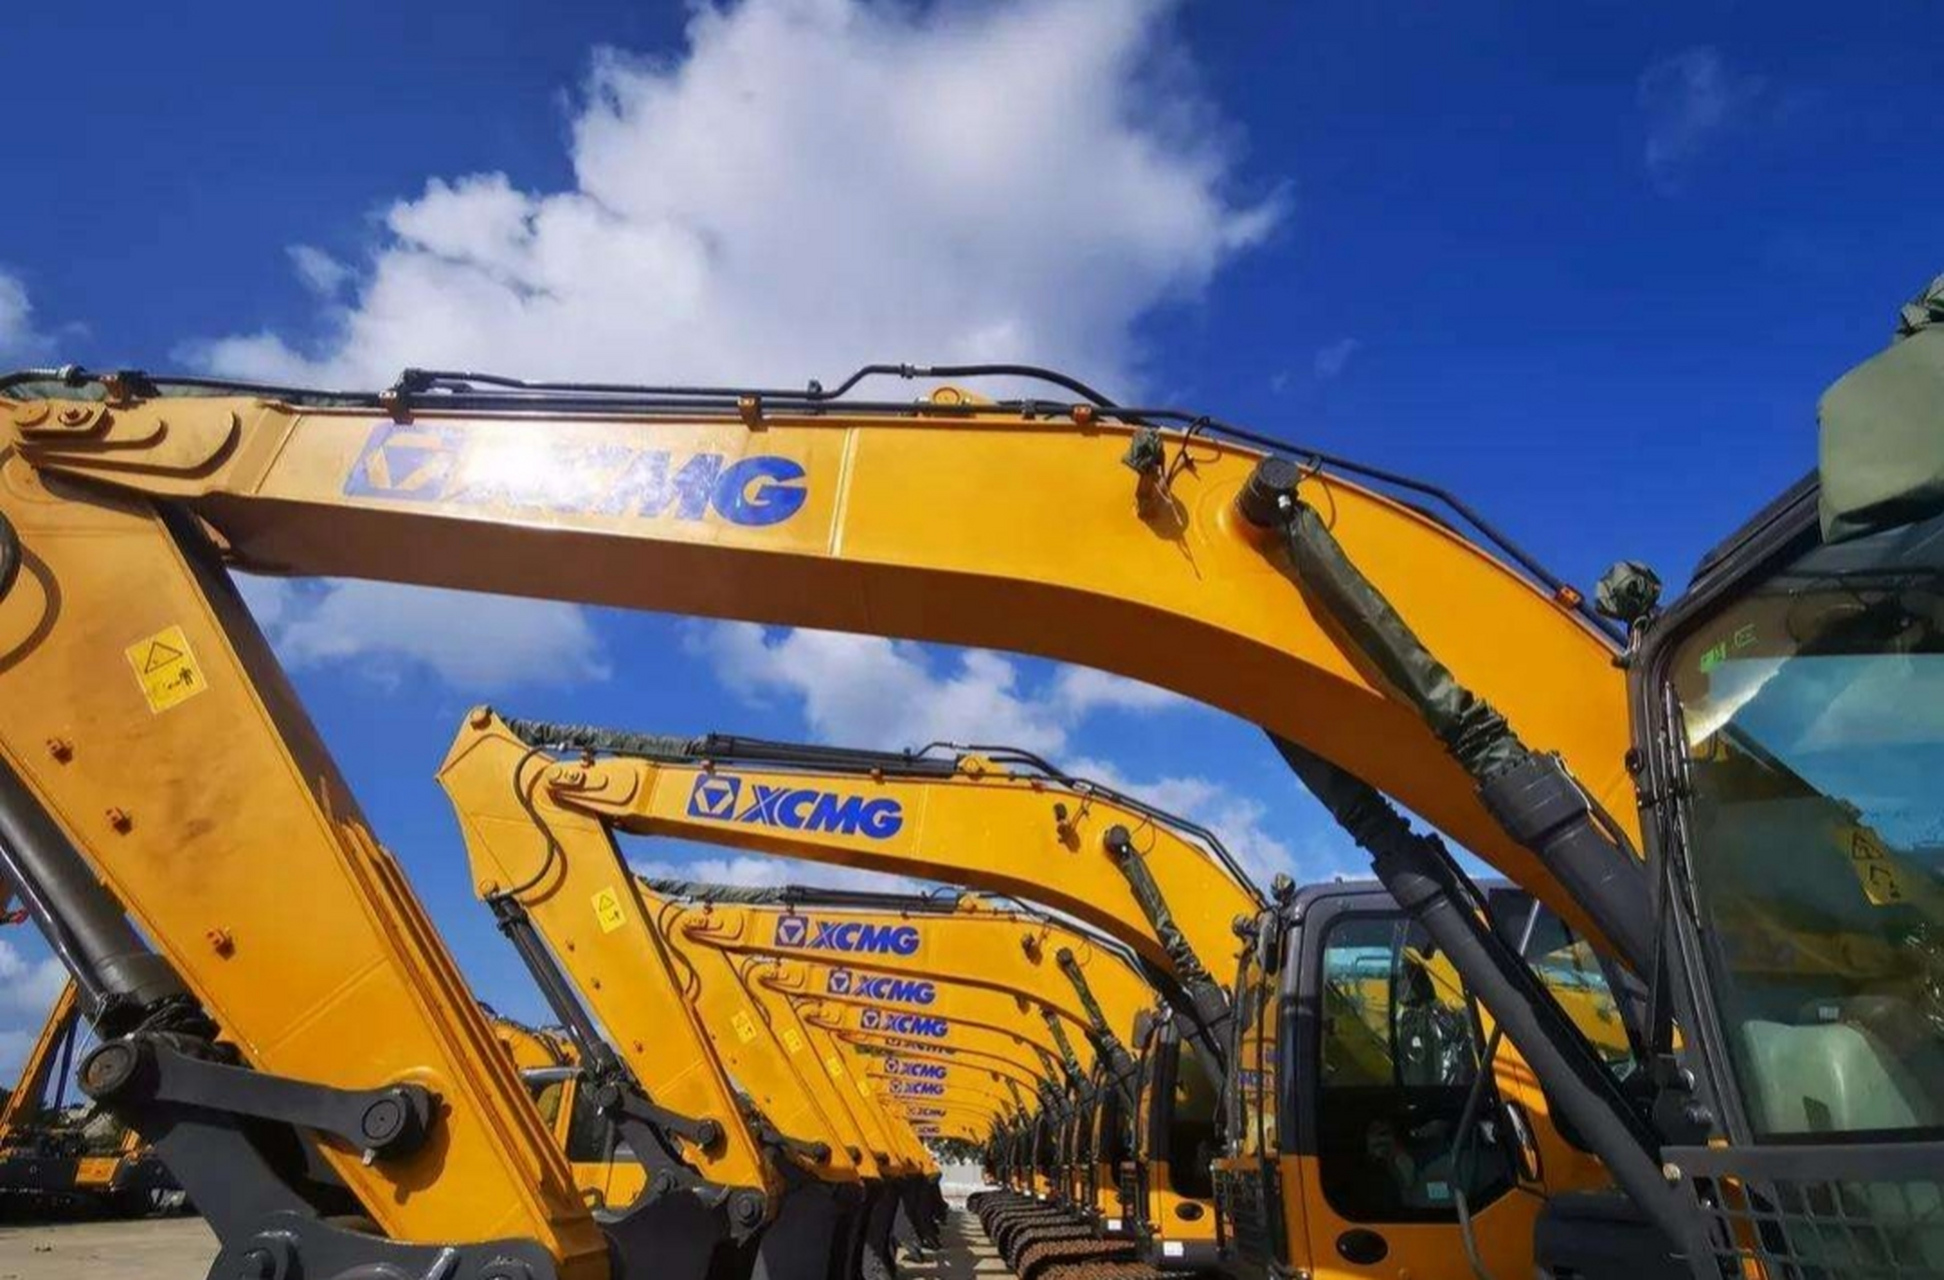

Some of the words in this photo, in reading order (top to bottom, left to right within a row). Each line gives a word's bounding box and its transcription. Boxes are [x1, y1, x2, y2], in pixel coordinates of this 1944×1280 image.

[441, 438, 808, 527] MG
[734, 785, 904, 839] XCMG
[809, 921, 920, 955] XCMG
[852, 975, 936, 1004] XCMG
[883, 1014, 947, 1037] XCMG
